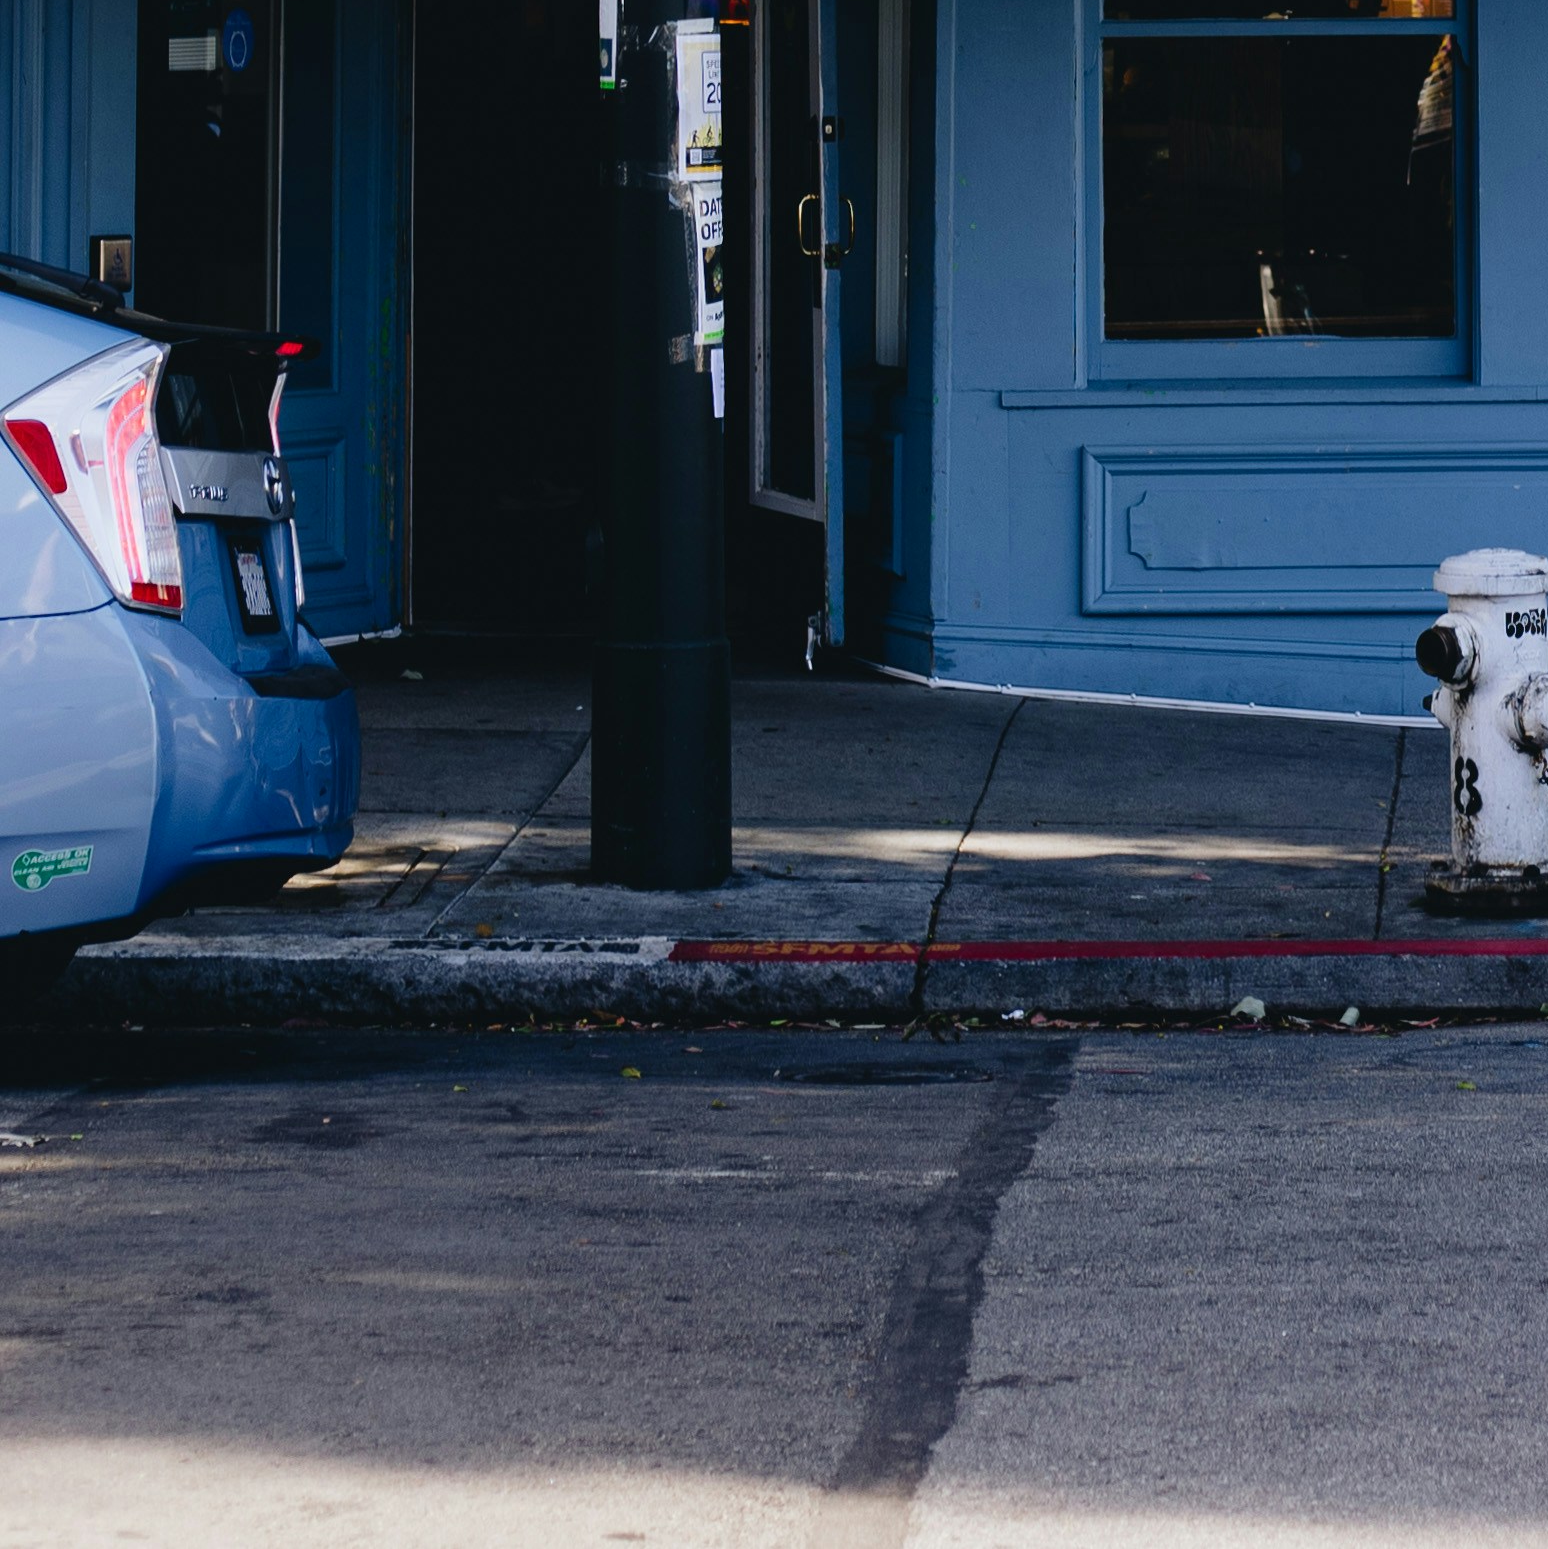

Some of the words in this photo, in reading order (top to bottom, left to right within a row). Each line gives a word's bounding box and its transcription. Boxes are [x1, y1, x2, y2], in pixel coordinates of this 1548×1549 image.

[30, 850, 72, 865] ACCESS
[74, 848, 90, 858] OK
[753, 942, 916, 955] SFMTA
